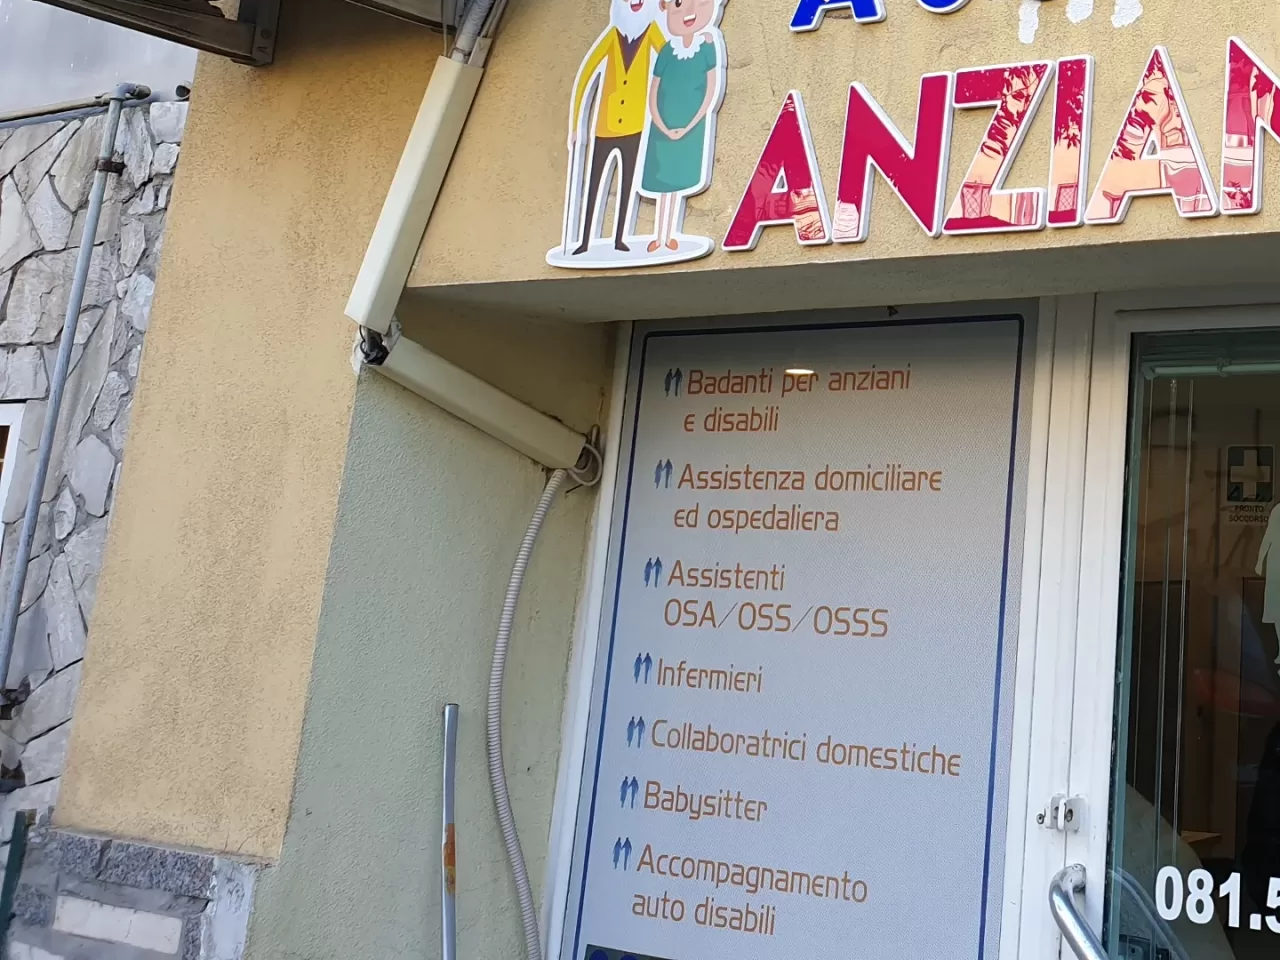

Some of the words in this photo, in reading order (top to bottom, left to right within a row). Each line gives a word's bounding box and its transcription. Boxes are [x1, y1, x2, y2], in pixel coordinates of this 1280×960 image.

[687, 368, 773, 395] Badanti
[781, 370, 819, 397] per
[828, 363, 911, 391] anziani
[683, 413, 695, 432] e
[703, 406, 779, 432] disabili
[677, 464, 805, 491] Assistenza
[814, 464, 943, 491] domiciliare
[674, 503, 699, 529] ed
[707, 504, 840, 534] ospedaliera
[667, 560, 785, 591] Assistenti
[657, 658, 763, 693] Infermieri
[651, 719, 807, 761] Collaboratrici
[816, 735, 962, 777] domestiche
[643, 780, 768, 822] Babysitter
[636, 844, 868, 903] Accompagnamento
[632, 891, 685, 922] auto
[694, 897, 776, 935] disabili
